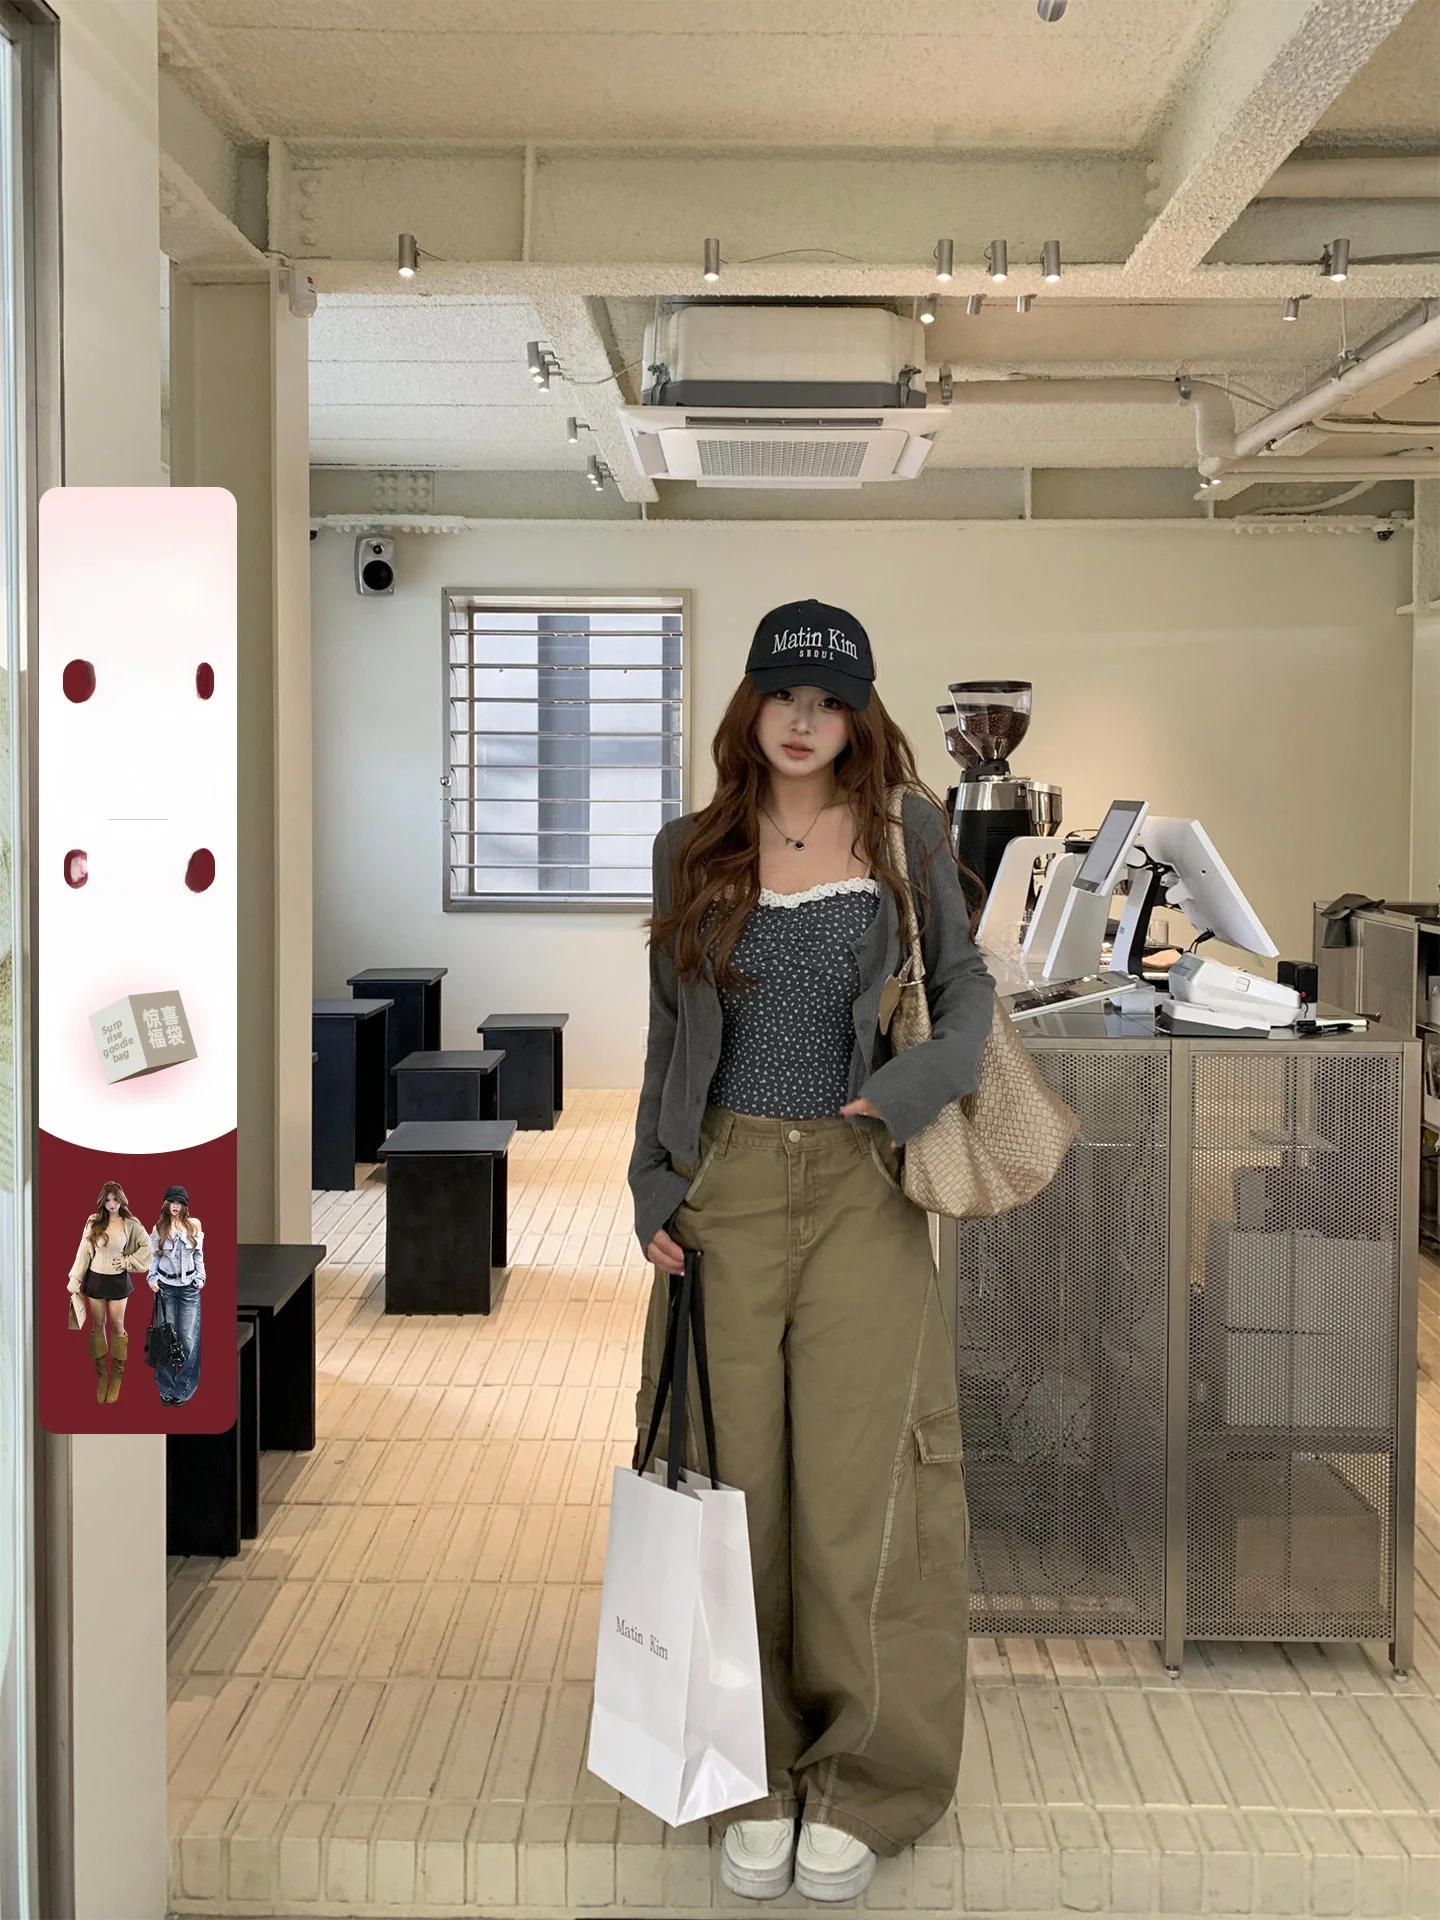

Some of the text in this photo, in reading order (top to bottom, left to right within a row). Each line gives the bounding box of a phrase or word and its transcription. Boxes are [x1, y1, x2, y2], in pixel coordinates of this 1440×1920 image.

[771, 626, 858, 660] Matin Kim
[799, 649, 834, 660] SEOUL
[616, 1616, 668, 1660] Matin Kim
